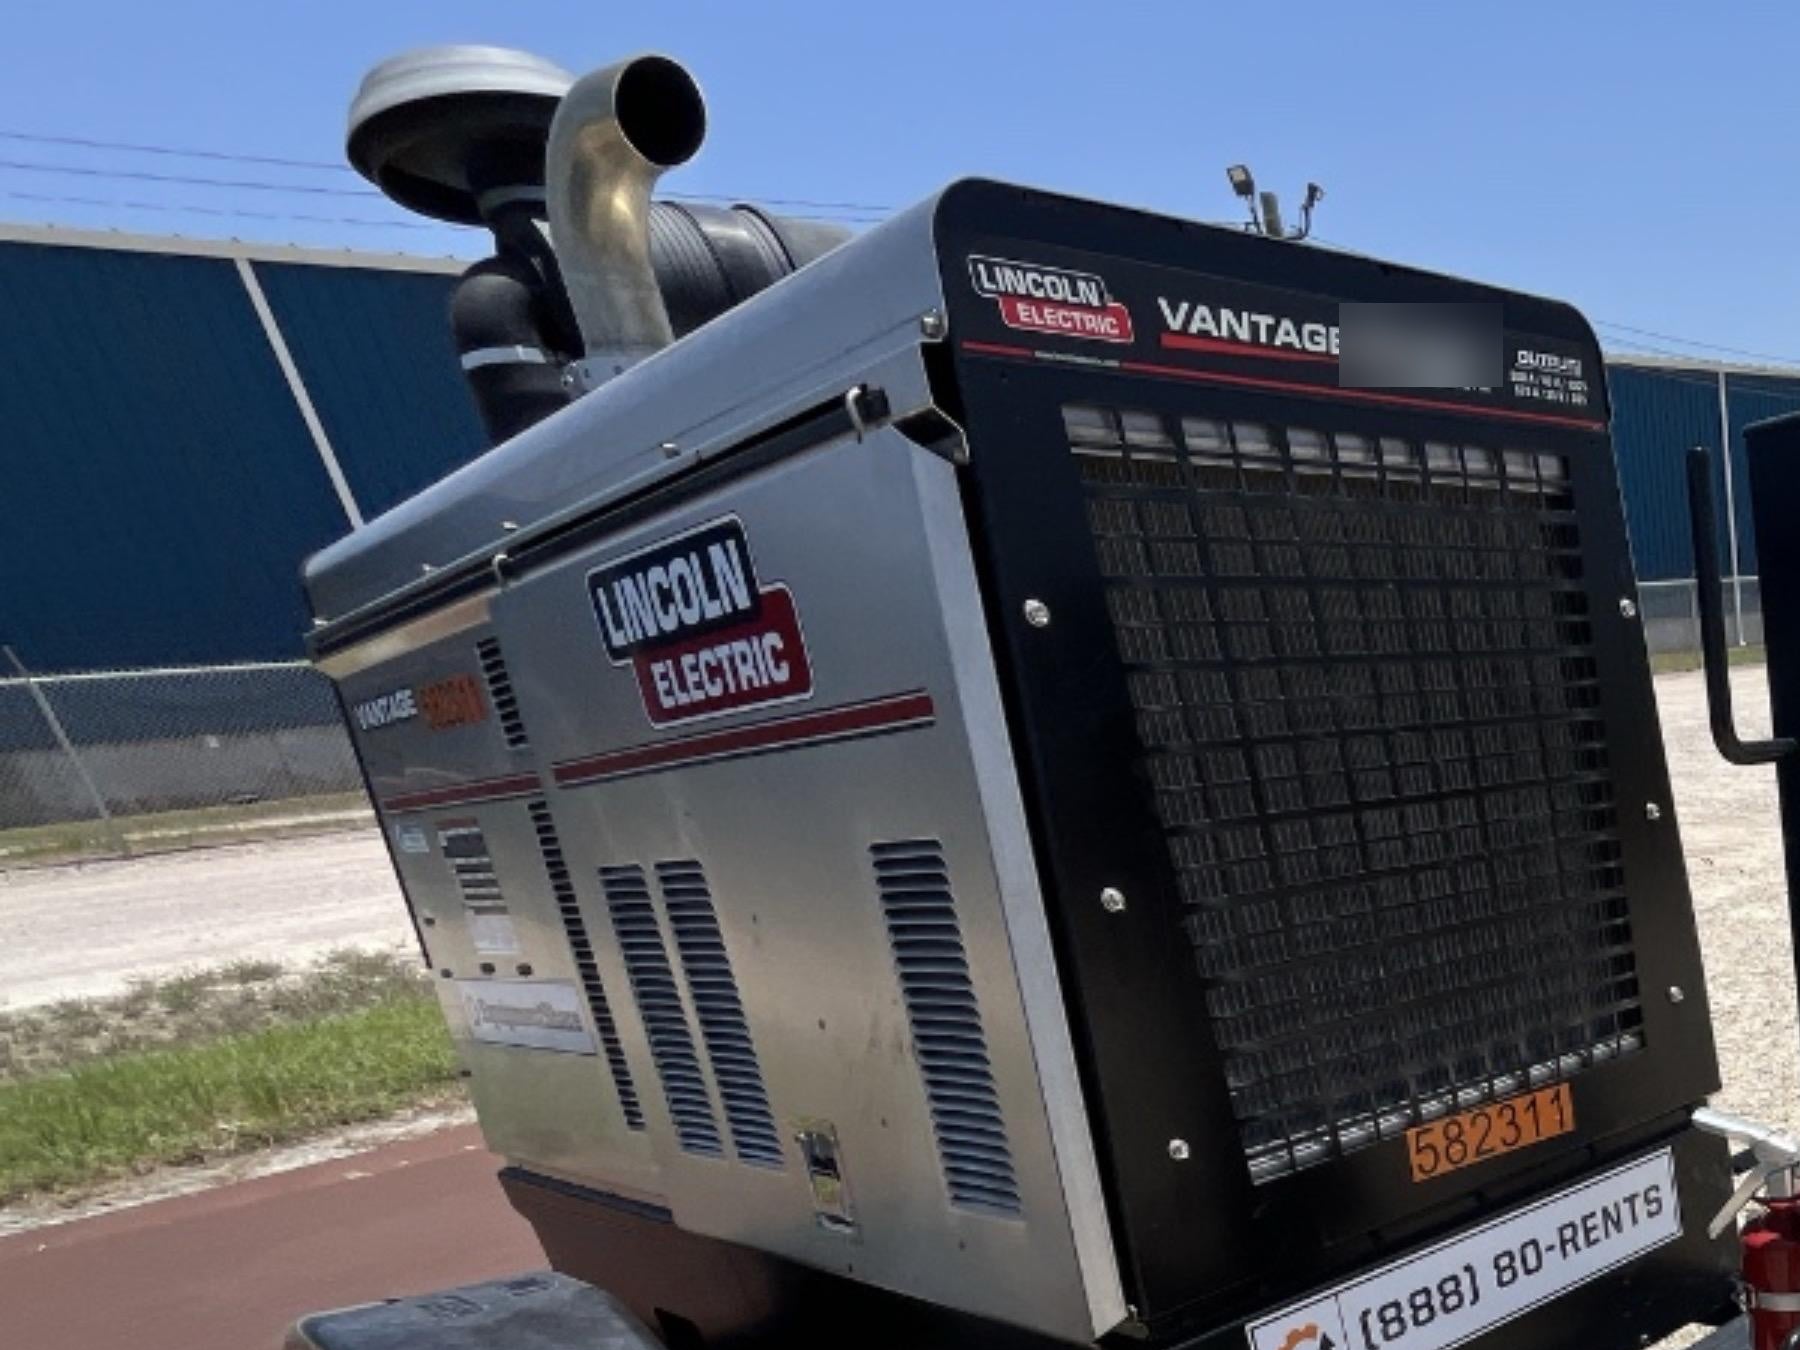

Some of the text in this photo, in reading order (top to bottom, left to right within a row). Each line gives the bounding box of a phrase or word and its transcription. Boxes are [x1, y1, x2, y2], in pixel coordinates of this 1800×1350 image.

[977, 262, 1101, 306] LINCOLN
[1016, 302, 1121, 335] ELECTRIC
[596, 539, 751, 647] LINCOLN
[651, 632, 791, 709] ELECTRIC
[1415, 1088, 1565, 1175] 582311
[1493, 1184, 1664, 1288] 80-RENTS
